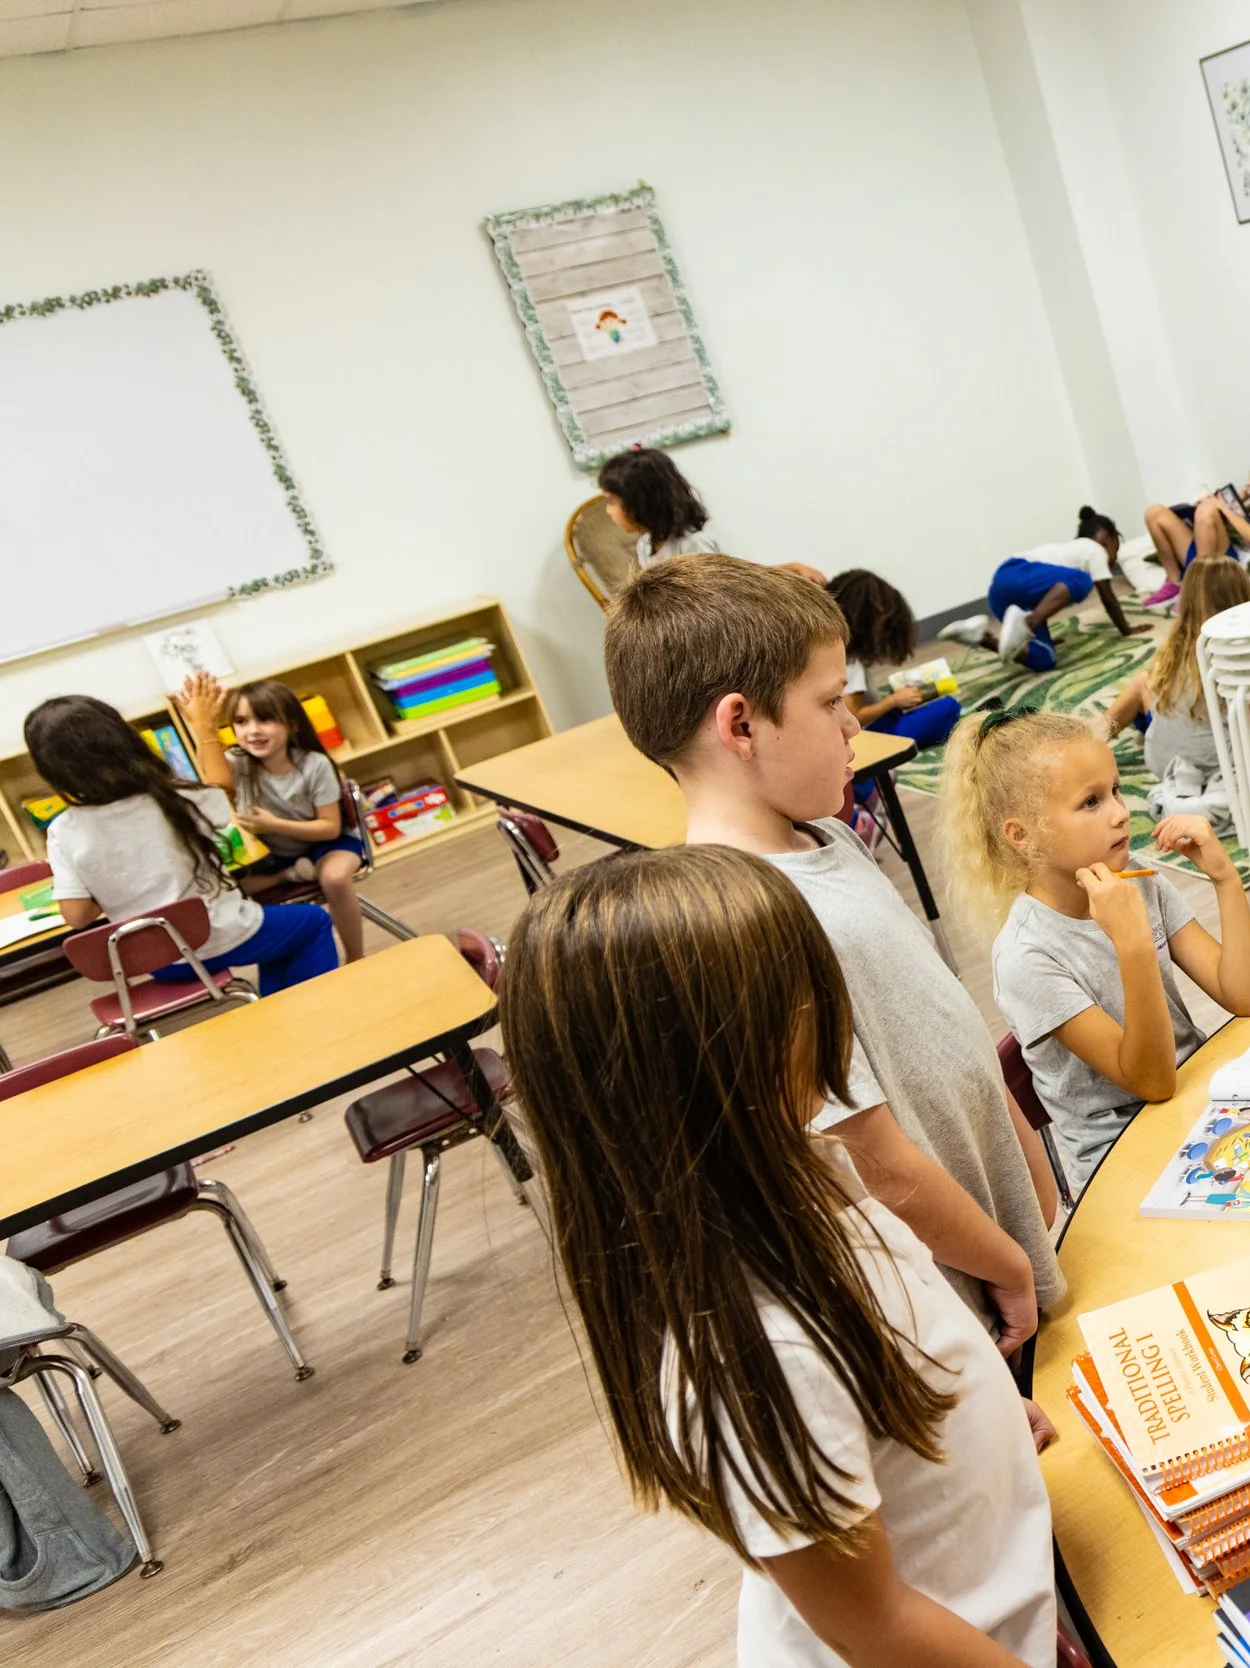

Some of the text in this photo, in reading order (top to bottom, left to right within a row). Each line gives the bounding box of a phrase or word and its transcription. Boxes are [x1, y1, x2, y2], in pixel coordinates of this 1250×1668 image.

[1108, 1327, 1170, 1445] TRADITIONAL
[1135, 1333, 1191, 1423] SPELLING I
[1175, 1328, 1219, 1403] Student Workbook
